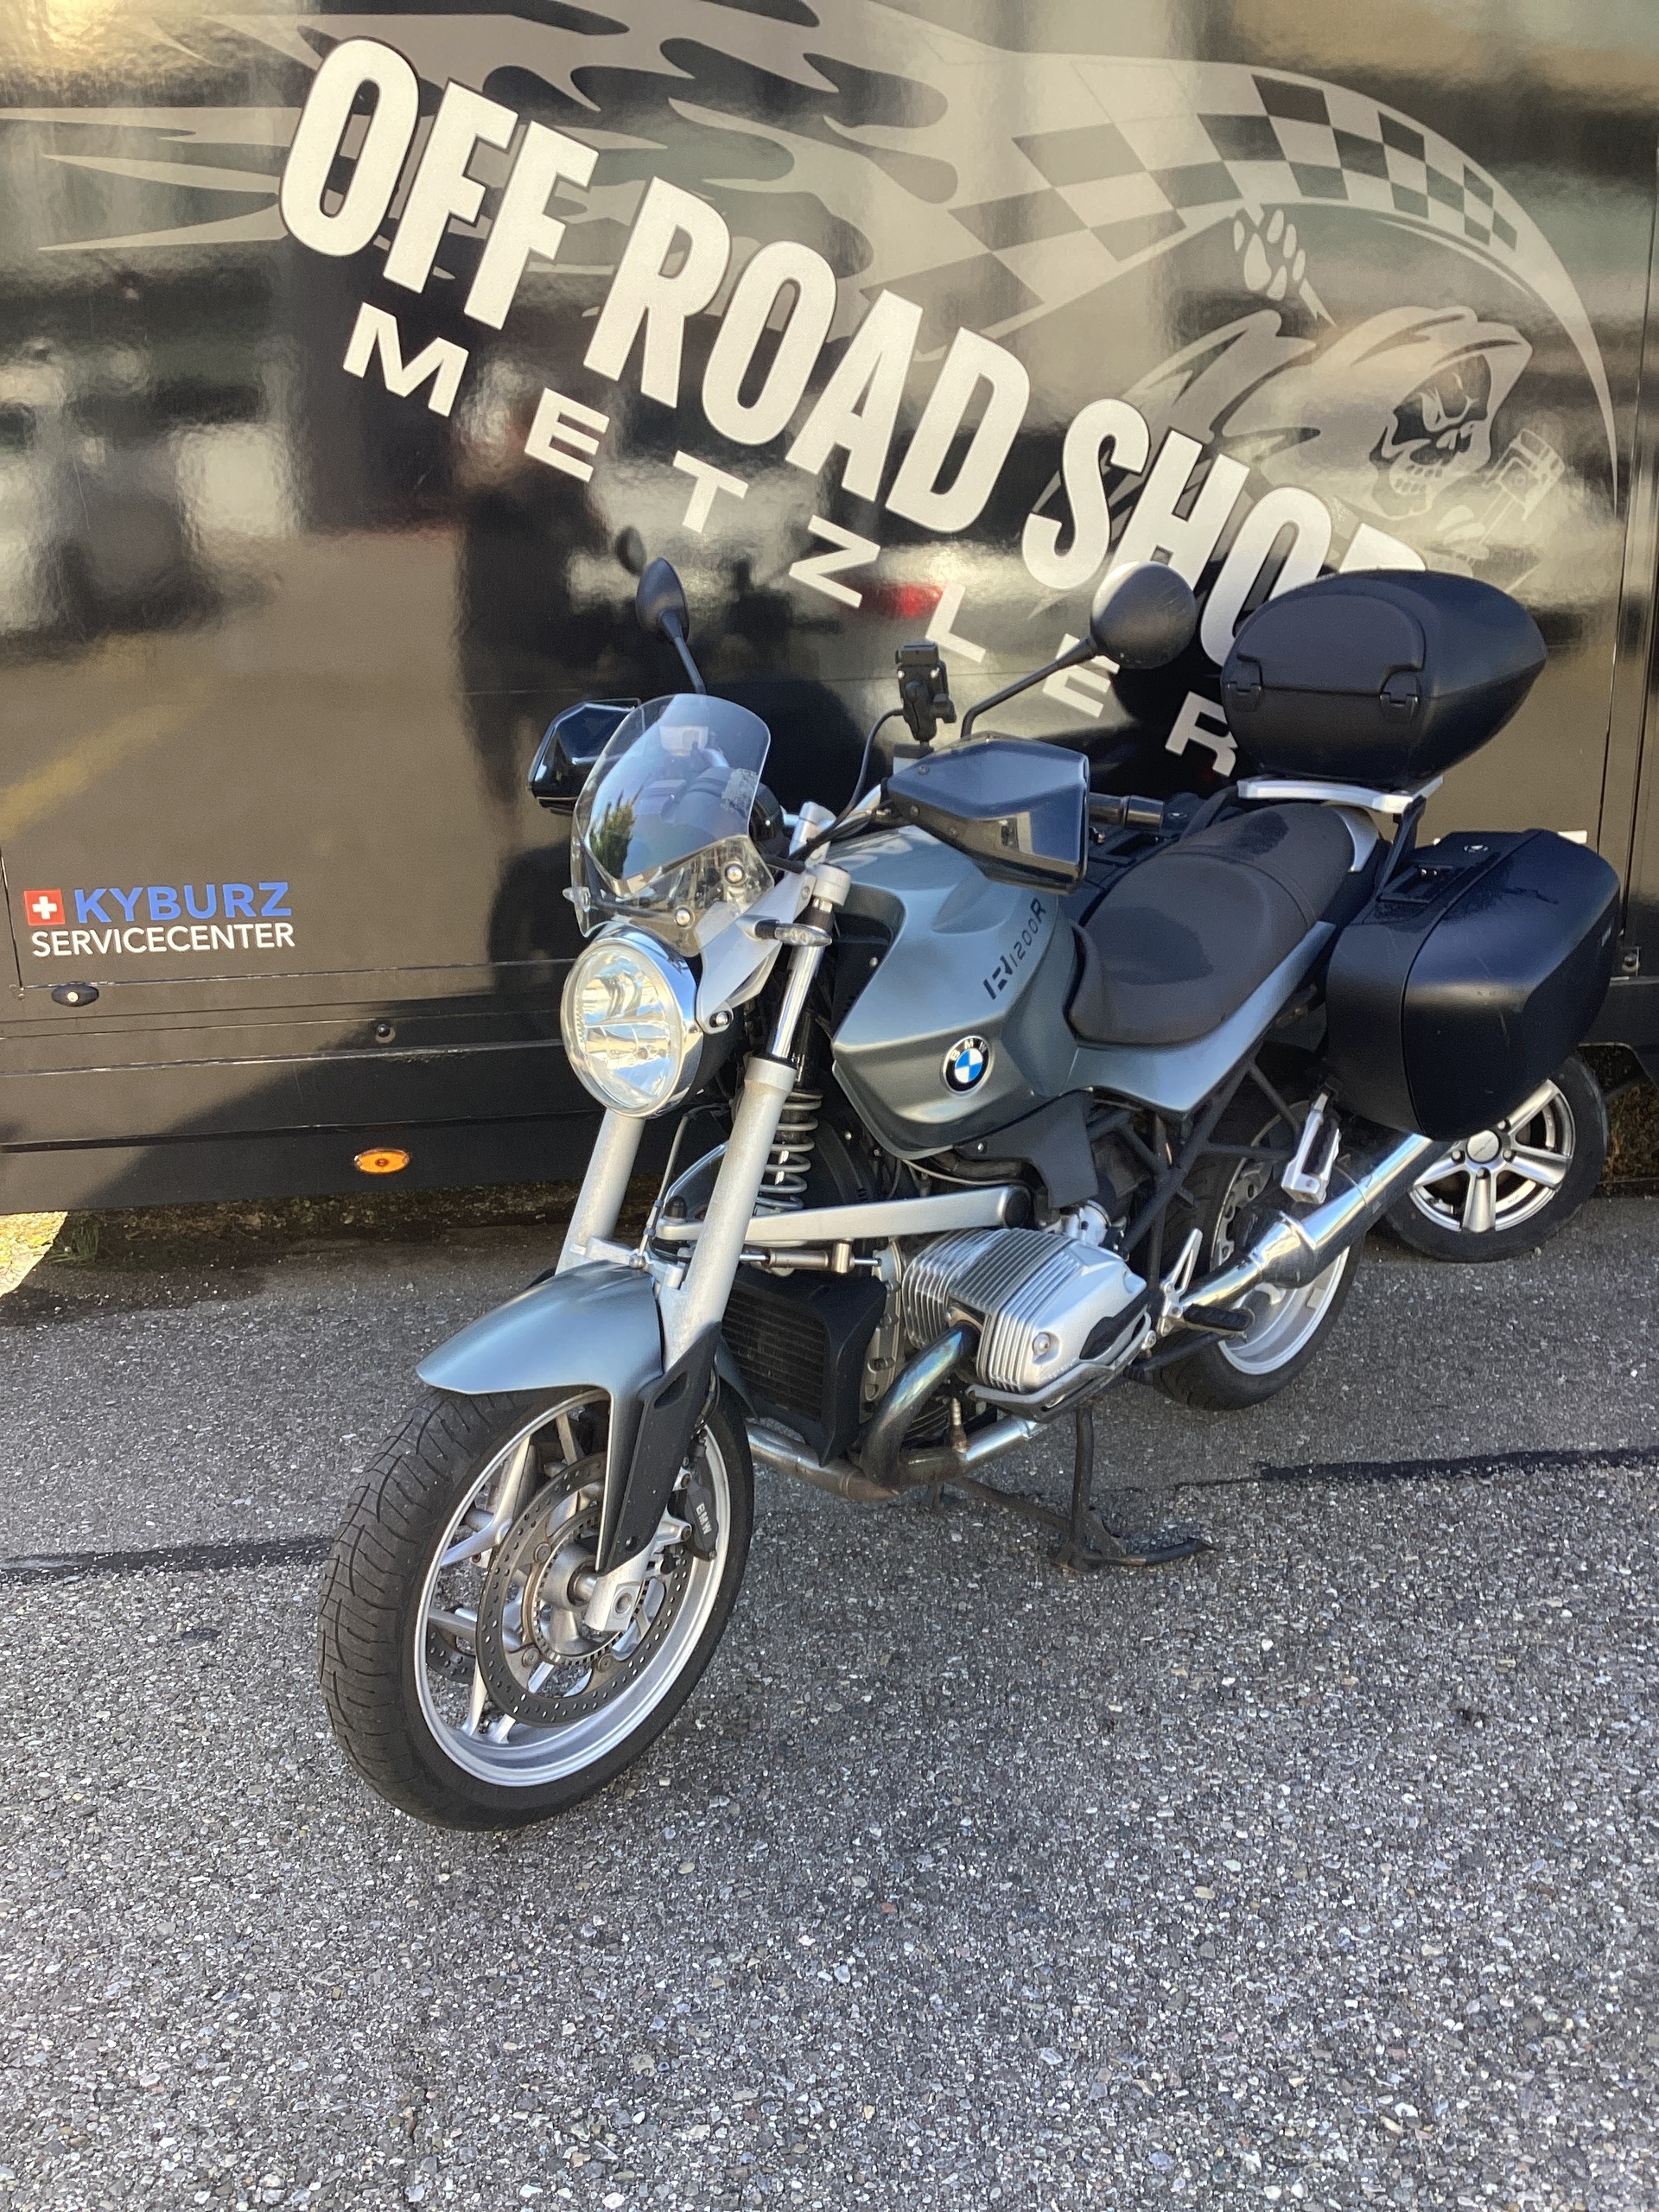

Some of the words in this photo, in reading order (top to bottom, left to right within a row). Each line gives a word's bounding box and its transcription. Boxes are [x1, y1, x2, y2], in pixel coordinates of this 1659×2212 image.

[280, 38, 600, 330] OFF
[582, 175, 1031, 533] ROAD
[1021, 398, 1427, 668] SHO
[342, 302, 1239, 779] METZLER
[73, 881, 292, 924] KYBURZ
[31, 922, 296, 957] SERVICECENTER
[949, 1038, 988, 1061] BMW
[696, 1502, 712, 1535] BMW
